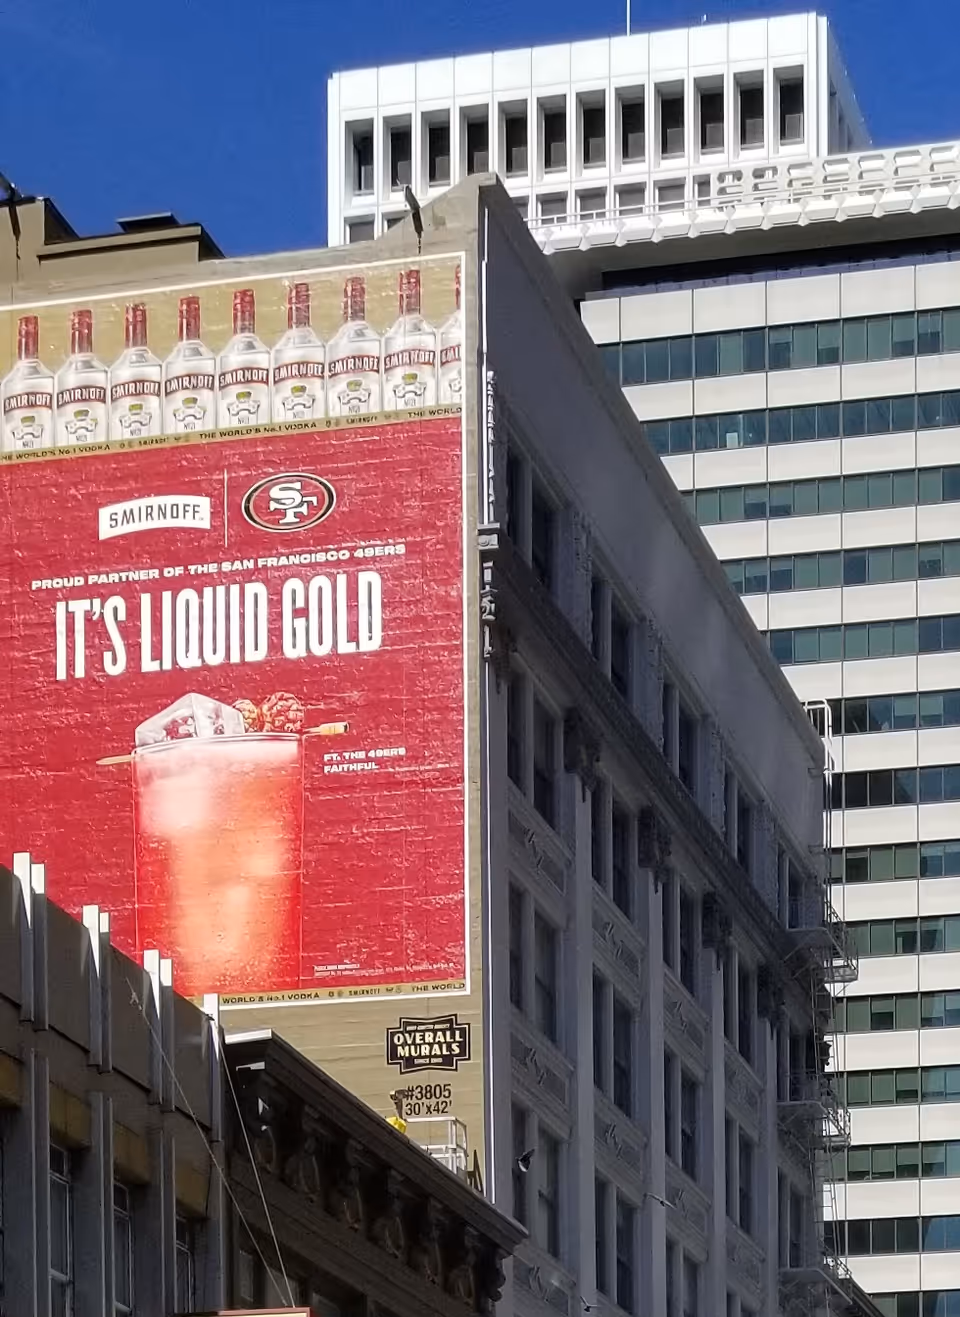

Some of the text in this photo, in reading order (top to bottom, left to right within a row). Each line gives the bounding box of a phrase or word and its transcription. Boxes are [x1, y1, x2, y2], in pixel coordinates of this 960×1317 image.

[407, 411, 423, 419] THE
[199, 432, 217, 440] THE
[219, 428, 261, 439] WORLD'S
[284, 421, 317, 431] VODKA
[78, 444, 111, 454] VODKA
[108, 503, 202, 529] SMIRNOFF
[31, 543, 406, 591] PROUD PARTNER OF THE SAN FRANCISCO 49ERS
[55, 570, 382, 681] IT'S LIQUID GOLD
[323, 747, 406, 762] FT. THE 49ERS
[323, 761, 378, 774] FAITHFUL
[432, 982, 465, 991] WORLD
[287, 991, 320, 1001] VODKA
[393, 1030, 463, 1045] OVERALL
[397, 1043, 461, 1057] MURALS
[405, 1083, 452, 1101] #3805
